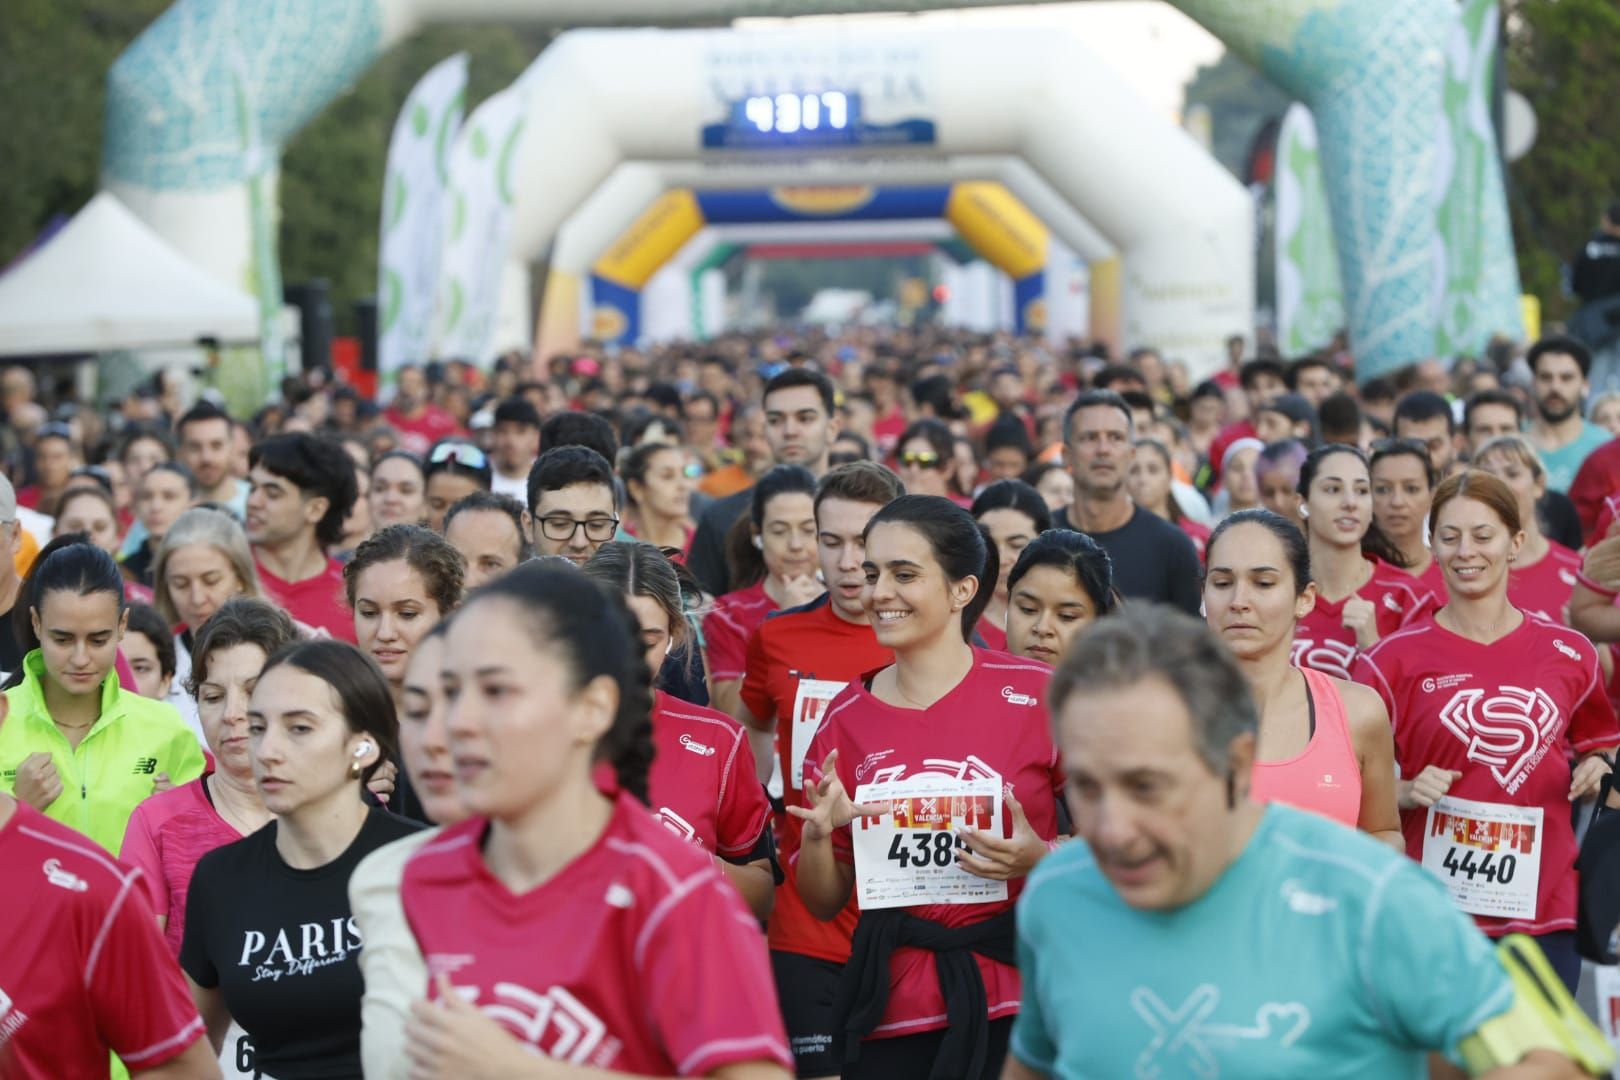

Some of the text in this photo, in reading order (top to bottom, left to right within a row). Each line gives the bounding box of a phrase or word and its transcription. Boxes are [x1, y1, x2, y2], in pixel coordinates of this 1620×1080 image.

[1442, 847, 1517, 885] 4440
[238, 916, 364, 966] PARIS
[252, 950, 347, 982] Stay Different
